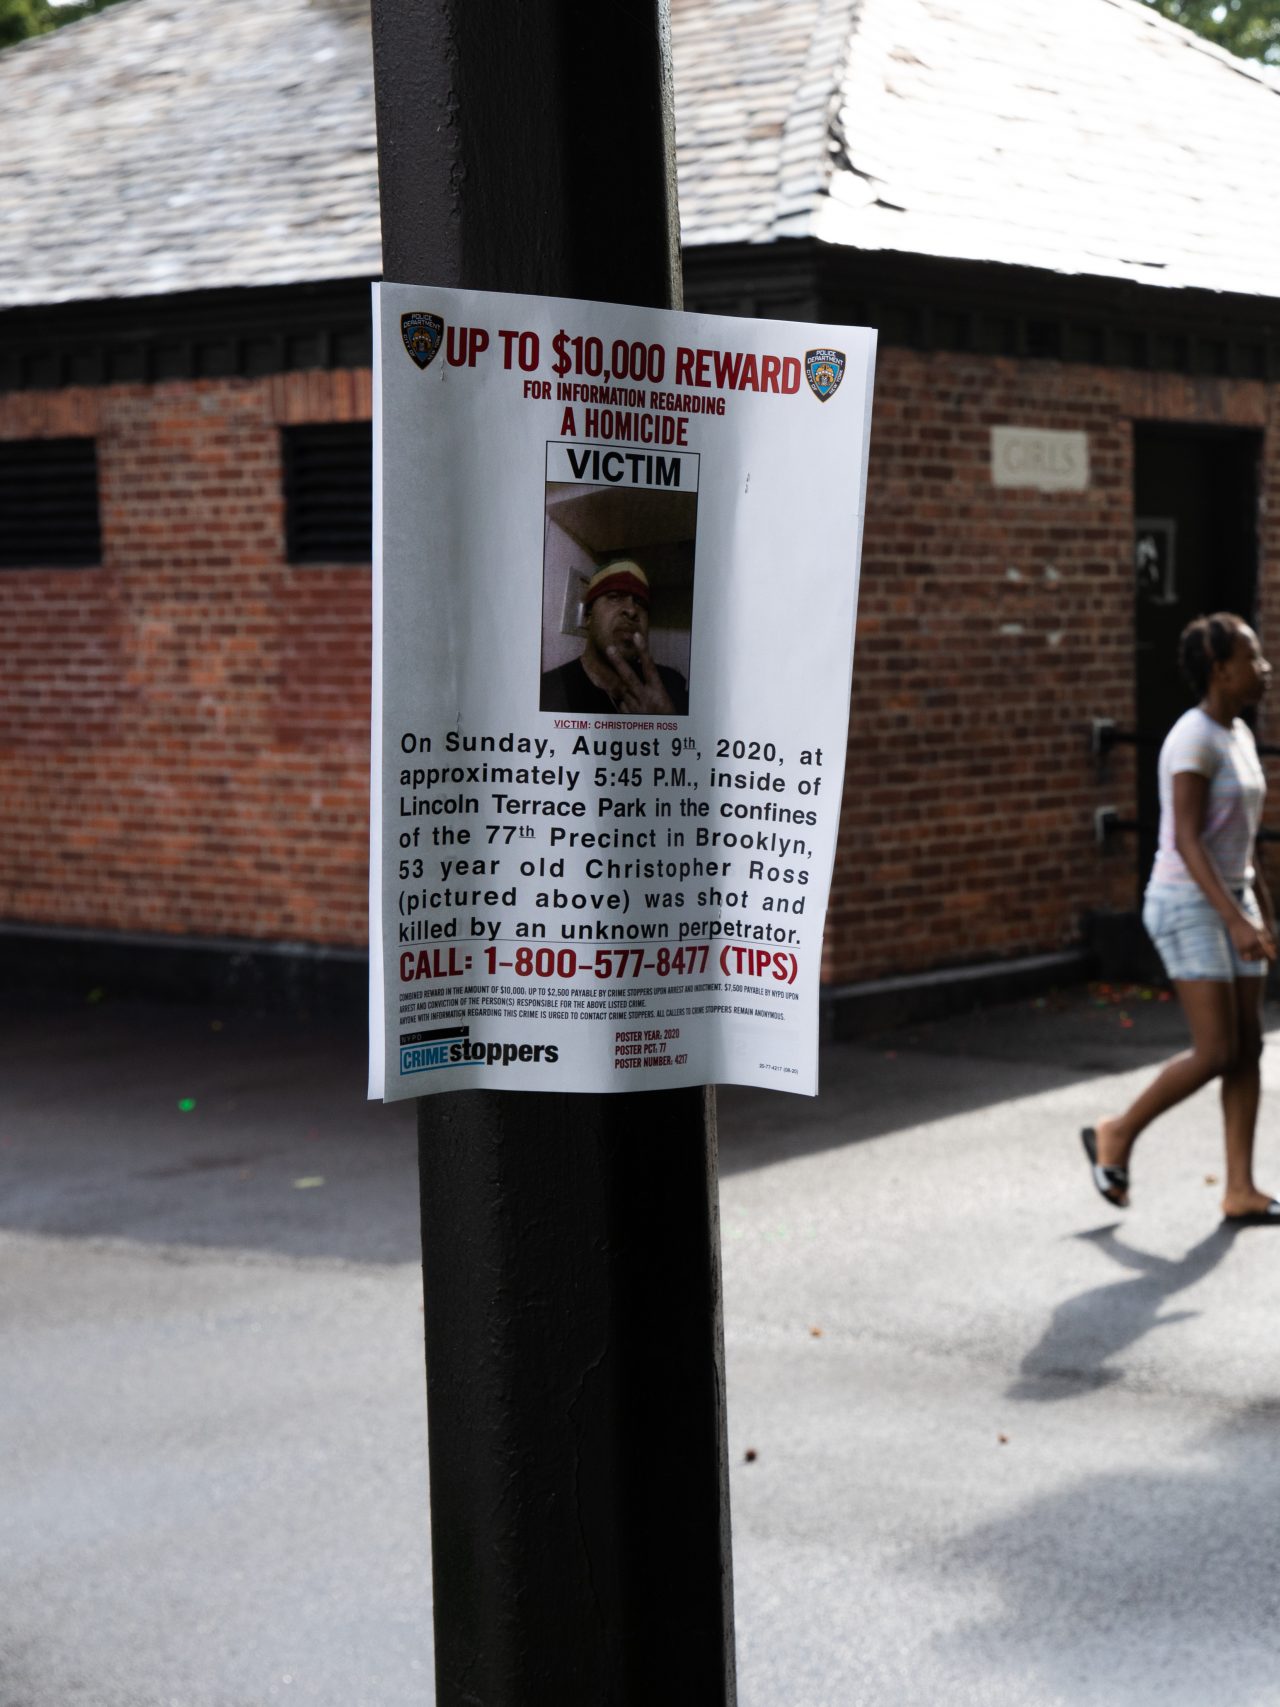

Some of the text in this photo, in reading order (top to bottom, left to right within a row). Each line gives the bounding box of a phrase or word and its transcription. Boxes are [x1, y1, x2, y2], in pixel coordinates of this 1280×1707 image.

[447, 326, 801, 394] UP TO $10,000 REWARD
[807, 355, 843, 365] DEPARTMENT
[524, 380, 726, 416] FOR INFORMATION REGARDING
[561, 407, 689, 446] A HOMICIDE
[566, 449, 681, 486] VICTIM
[554, 720, 678, 730] VICTIM: CHRISTOPHER ROSS
[401, 730, 823, 766] On Sunday, August 9th, 2020, at
[400, 763, 821, 796] approximately 5:45 P.M., inside of
[400, 794, 817, 826] Lincoln Terrace Park in the confines
[399, 825, 812, 859] of the 77th Precinct in Brooklyn,
[399, 858, 809, 885] 53 year old Christopher Ross
[399, 887, 805, 916] (pictured above) was shot and
[399, 918, 800, 944] killed by an unknown perpetrator.
[400, 943, 798, 985] CALL: 1-800-577-8477 (TIPS)
[416, 1002, 426, 1010] AND
[428, 998, 459, 1009] CONVICTION
[468, 997, 480, 1005] THE
[482, 997, 515, 1006] PERSON(S)
[517, 999, 558, 1007] RESPONSIBLE
[560, 1000, 571, 1008] FOR
[587, 1001, 607, 1009] ABOVE
[608, 1000, 627, 1008] LISTED
[424, 988, 445, 997] REWARD
[446, 987, 452, 995] IN
[453, 986, 463, 995] THE
[464, 986, 490, 994] AMOUNT
[547, 987, 570, 997] $2,500
[571, 989, 597, 997] PAYABLE
[599, 989, 607, 997] BY
[608, 989, 626, 997] CRIME
[627, 988, 653, 996] STOPPERS
[653, 987, 667, 995] UPON
[744, 985, 764, 995] PAYABLE
[764, 988, 771, 996] BY
[771, 990, 785, 999] NYPD
[785, 992, 799, 1000] UPON
[418, 1013, 430, 1022] WITH
[431, 1010, 466, 1020] INFORMATION
[467, 1009, 502, 1017] REGARDING
[519, 1010, 539, 1018] CRIME
[580, 1012, 607, 1020] CONTACT
[608, 1011, 627, 1020] CRIME
[705, 1005, 732, 1014] STOPPERS
[734, 1007, 754, 1015] REMAIN
[615, 1045, 641, 1055] POSTER
[659, 1042, 666, 1053] 77
[616, 1028, 680, 1042] POSTER YEAR: 2020
[615, 1054, 688, 1069] POSTER NUMBER: 4217
